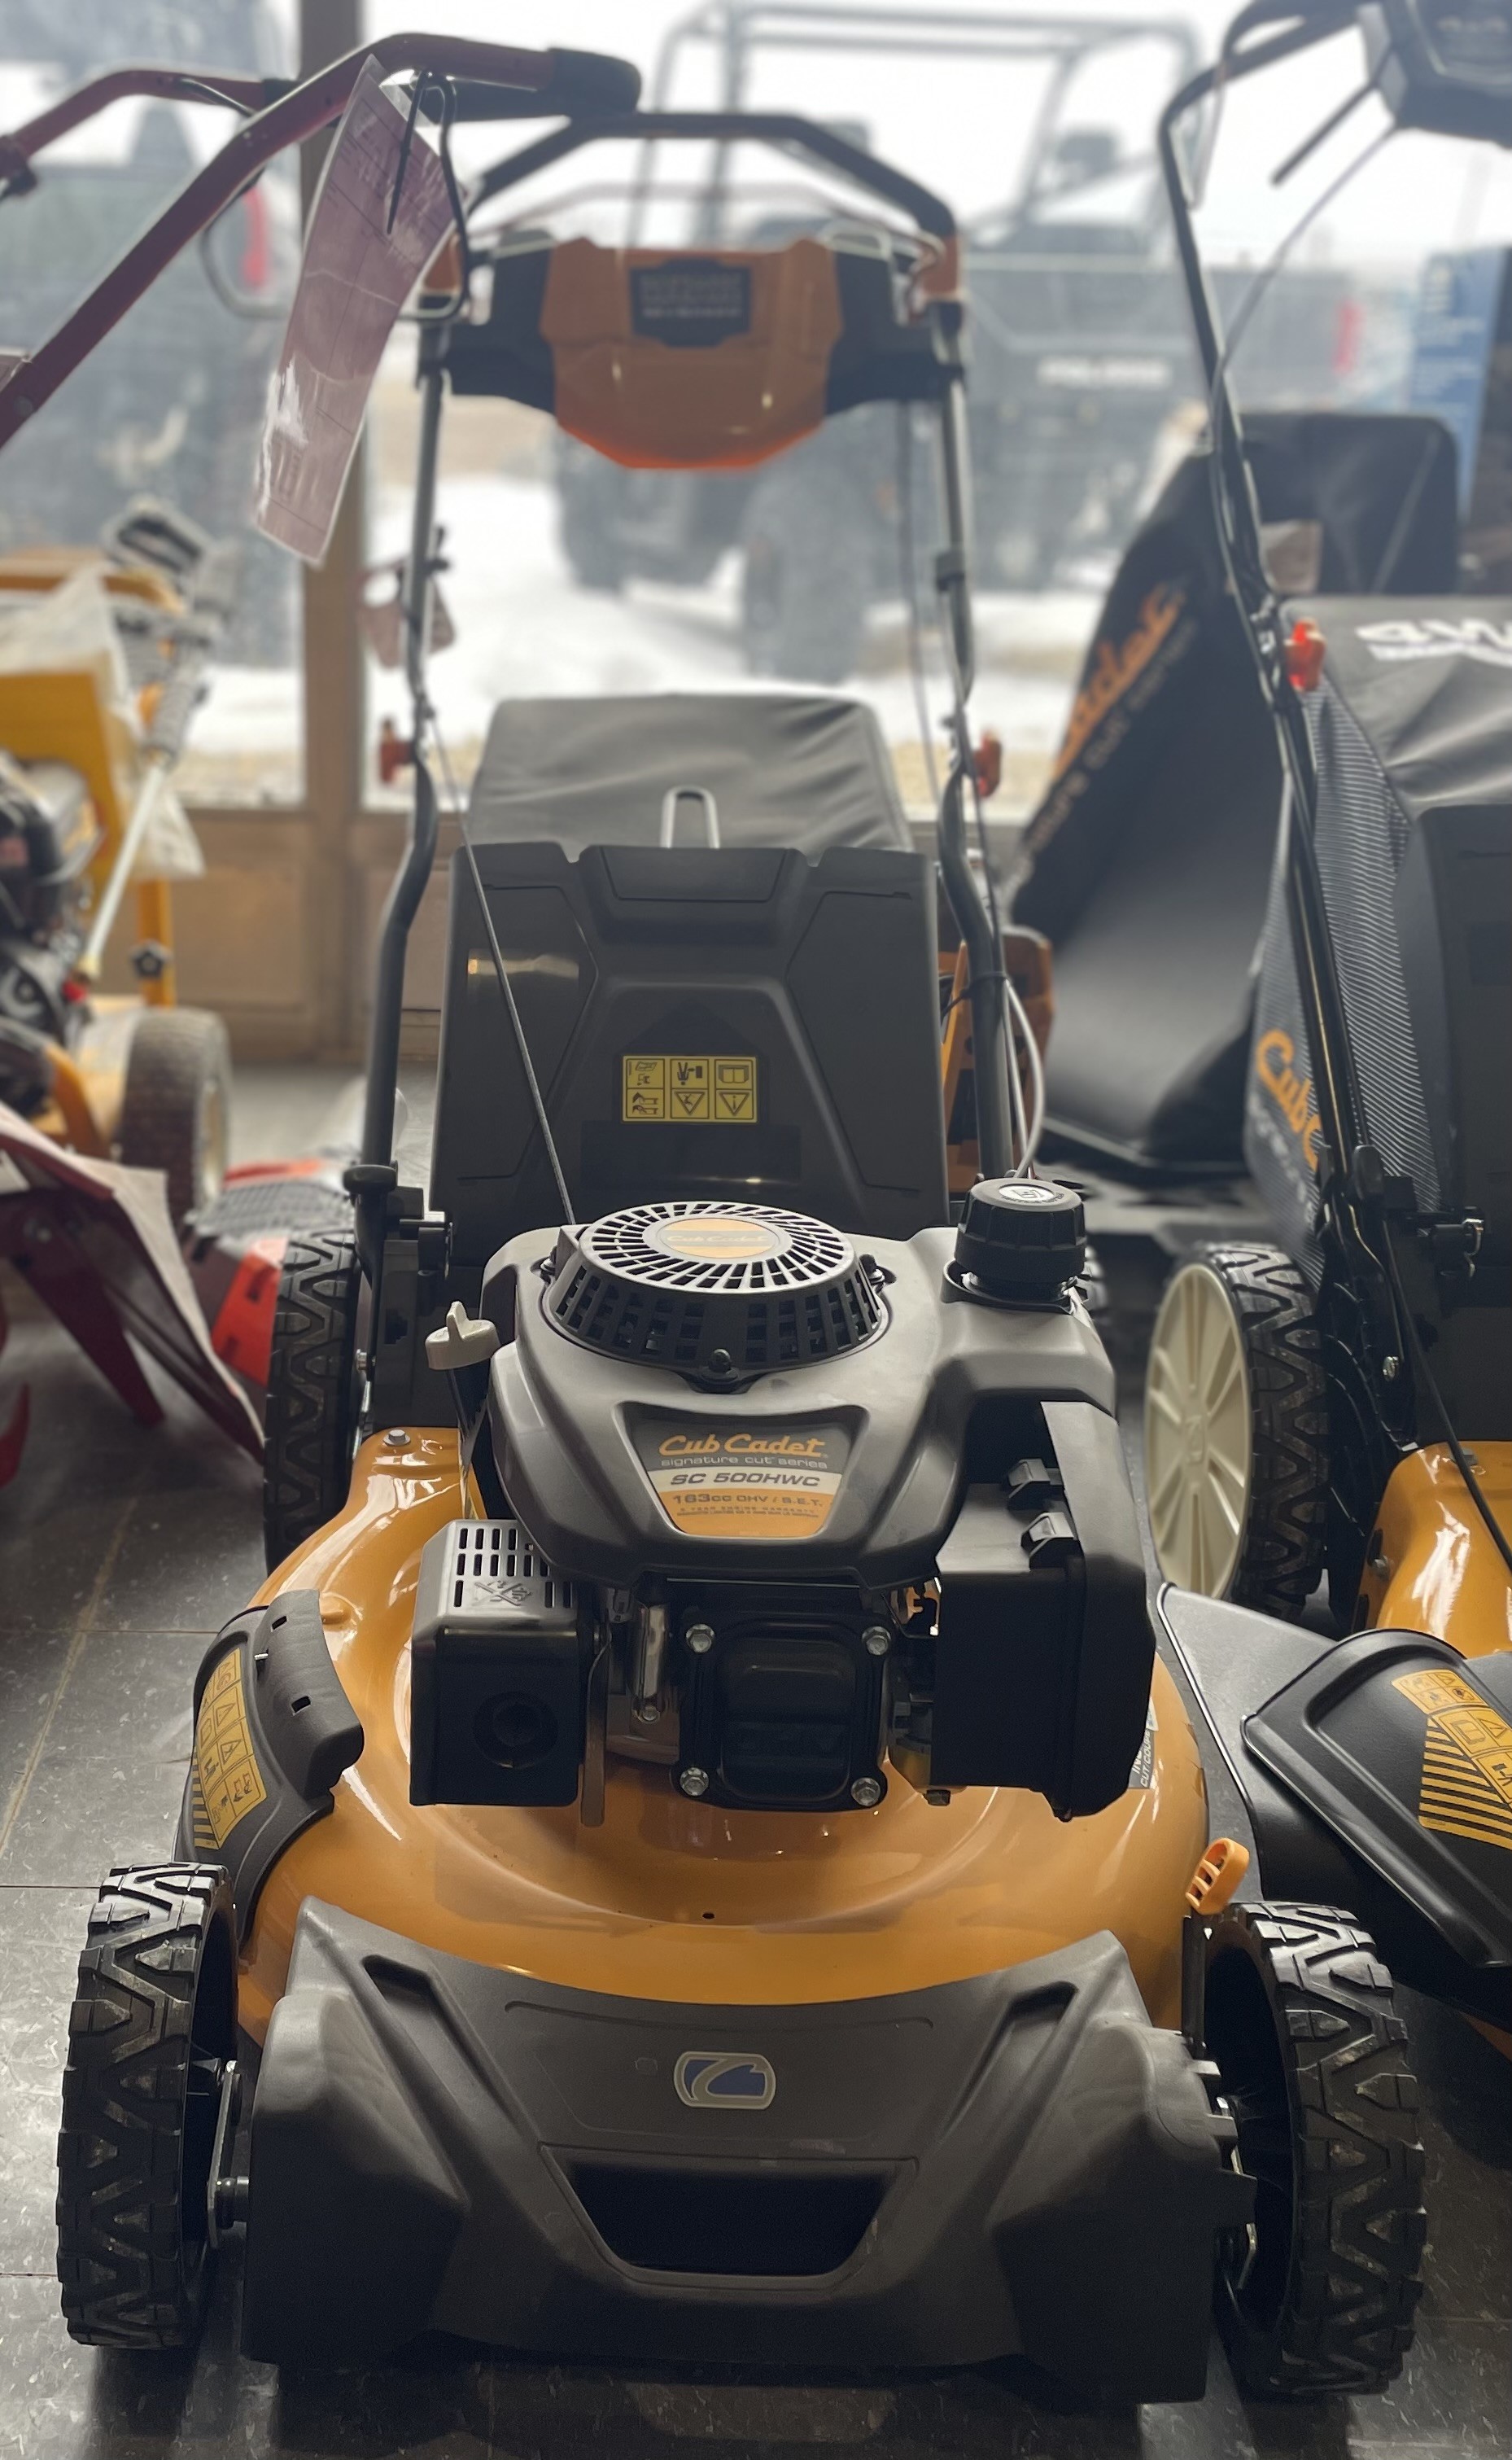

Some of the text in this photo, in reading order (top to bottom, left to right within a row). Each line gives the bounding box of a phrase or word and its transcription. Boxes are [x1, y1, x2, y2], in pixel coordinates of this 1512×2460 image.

[1256, 1028, 1312, 1133] Cub
[658, 1433, 826, 1458] Cub Cadet
[661, 1456, 828, 1469] signature cut series
[670, 1473, 820, 1487] SC 500HWC
[673, 1493, 732, 1505] 163cc
